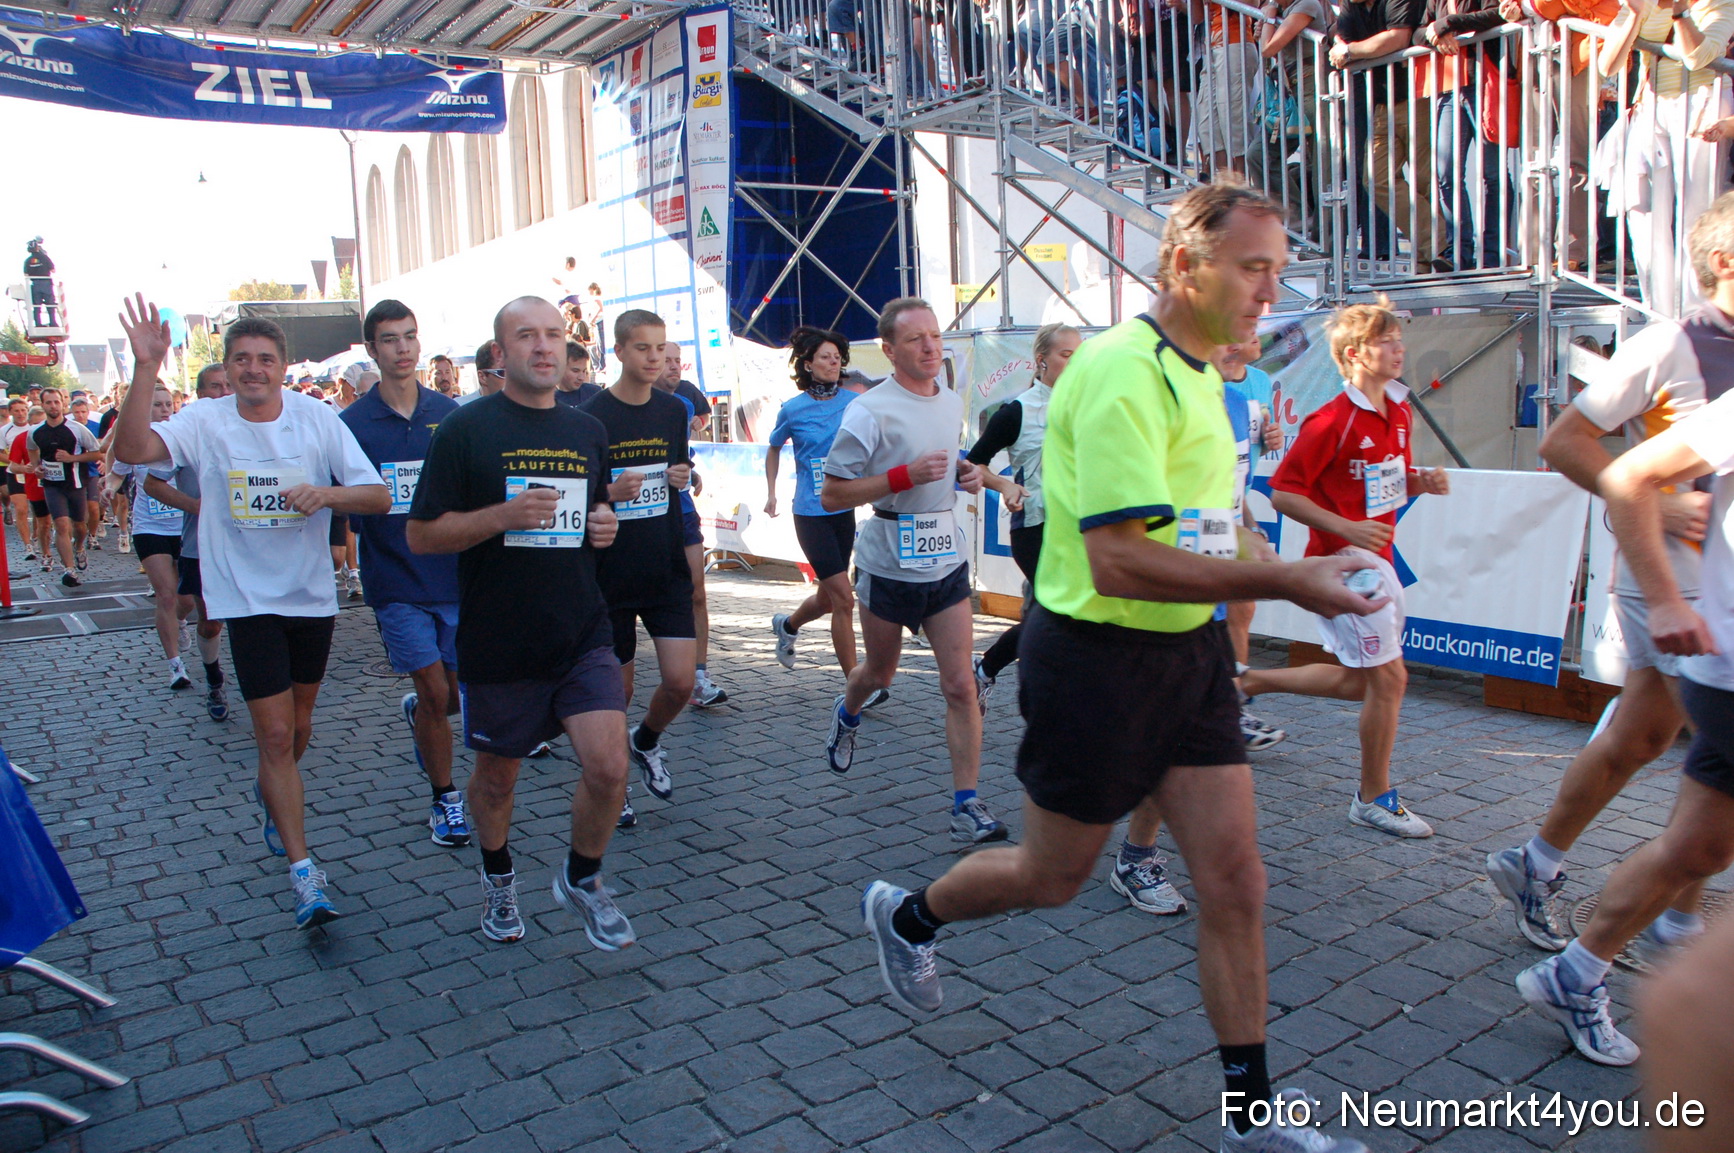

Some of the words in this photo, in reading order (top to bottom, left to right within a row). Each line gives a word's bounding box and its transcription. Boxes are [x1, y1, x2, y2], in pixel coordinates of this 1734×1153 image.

[191, 62, 332, 109] ZIEL
[978, 360, 1022, 398] Wasser
[397, 467, 422, 477] Chris
[644, 471, 664, 481] annes
[248, 476, 279, 487] Klaus
[234, 492, 243, 501] A
[251, 494, 299, 512] 428
[916, 519, 938, 529] Josef
[903, 535, 910, 543] B
[917, 535, 952, 552] 2099
